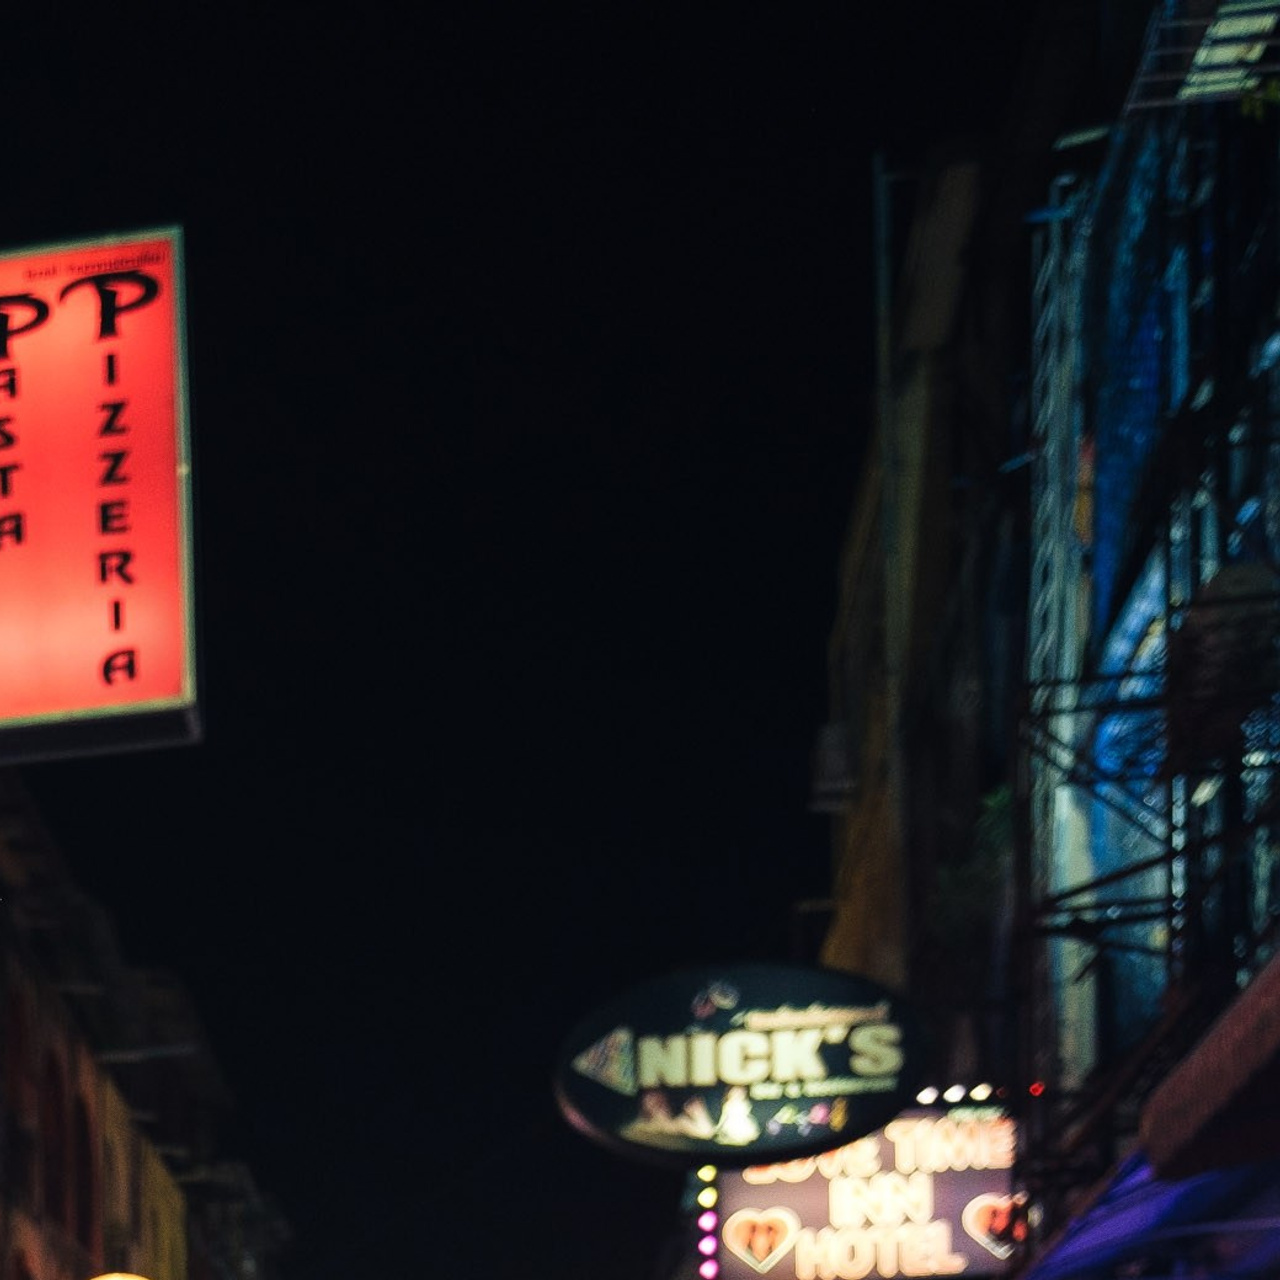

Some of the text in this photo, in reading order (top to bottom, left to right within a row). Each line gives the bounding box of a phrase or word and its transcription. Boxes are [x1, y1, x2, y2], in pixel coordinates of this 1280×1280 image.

[58, 269, 160, 687] PIZZERIA
[637, 1022, 904, 1089] NICK'S
[828, 1170, 934, 1229] INN
